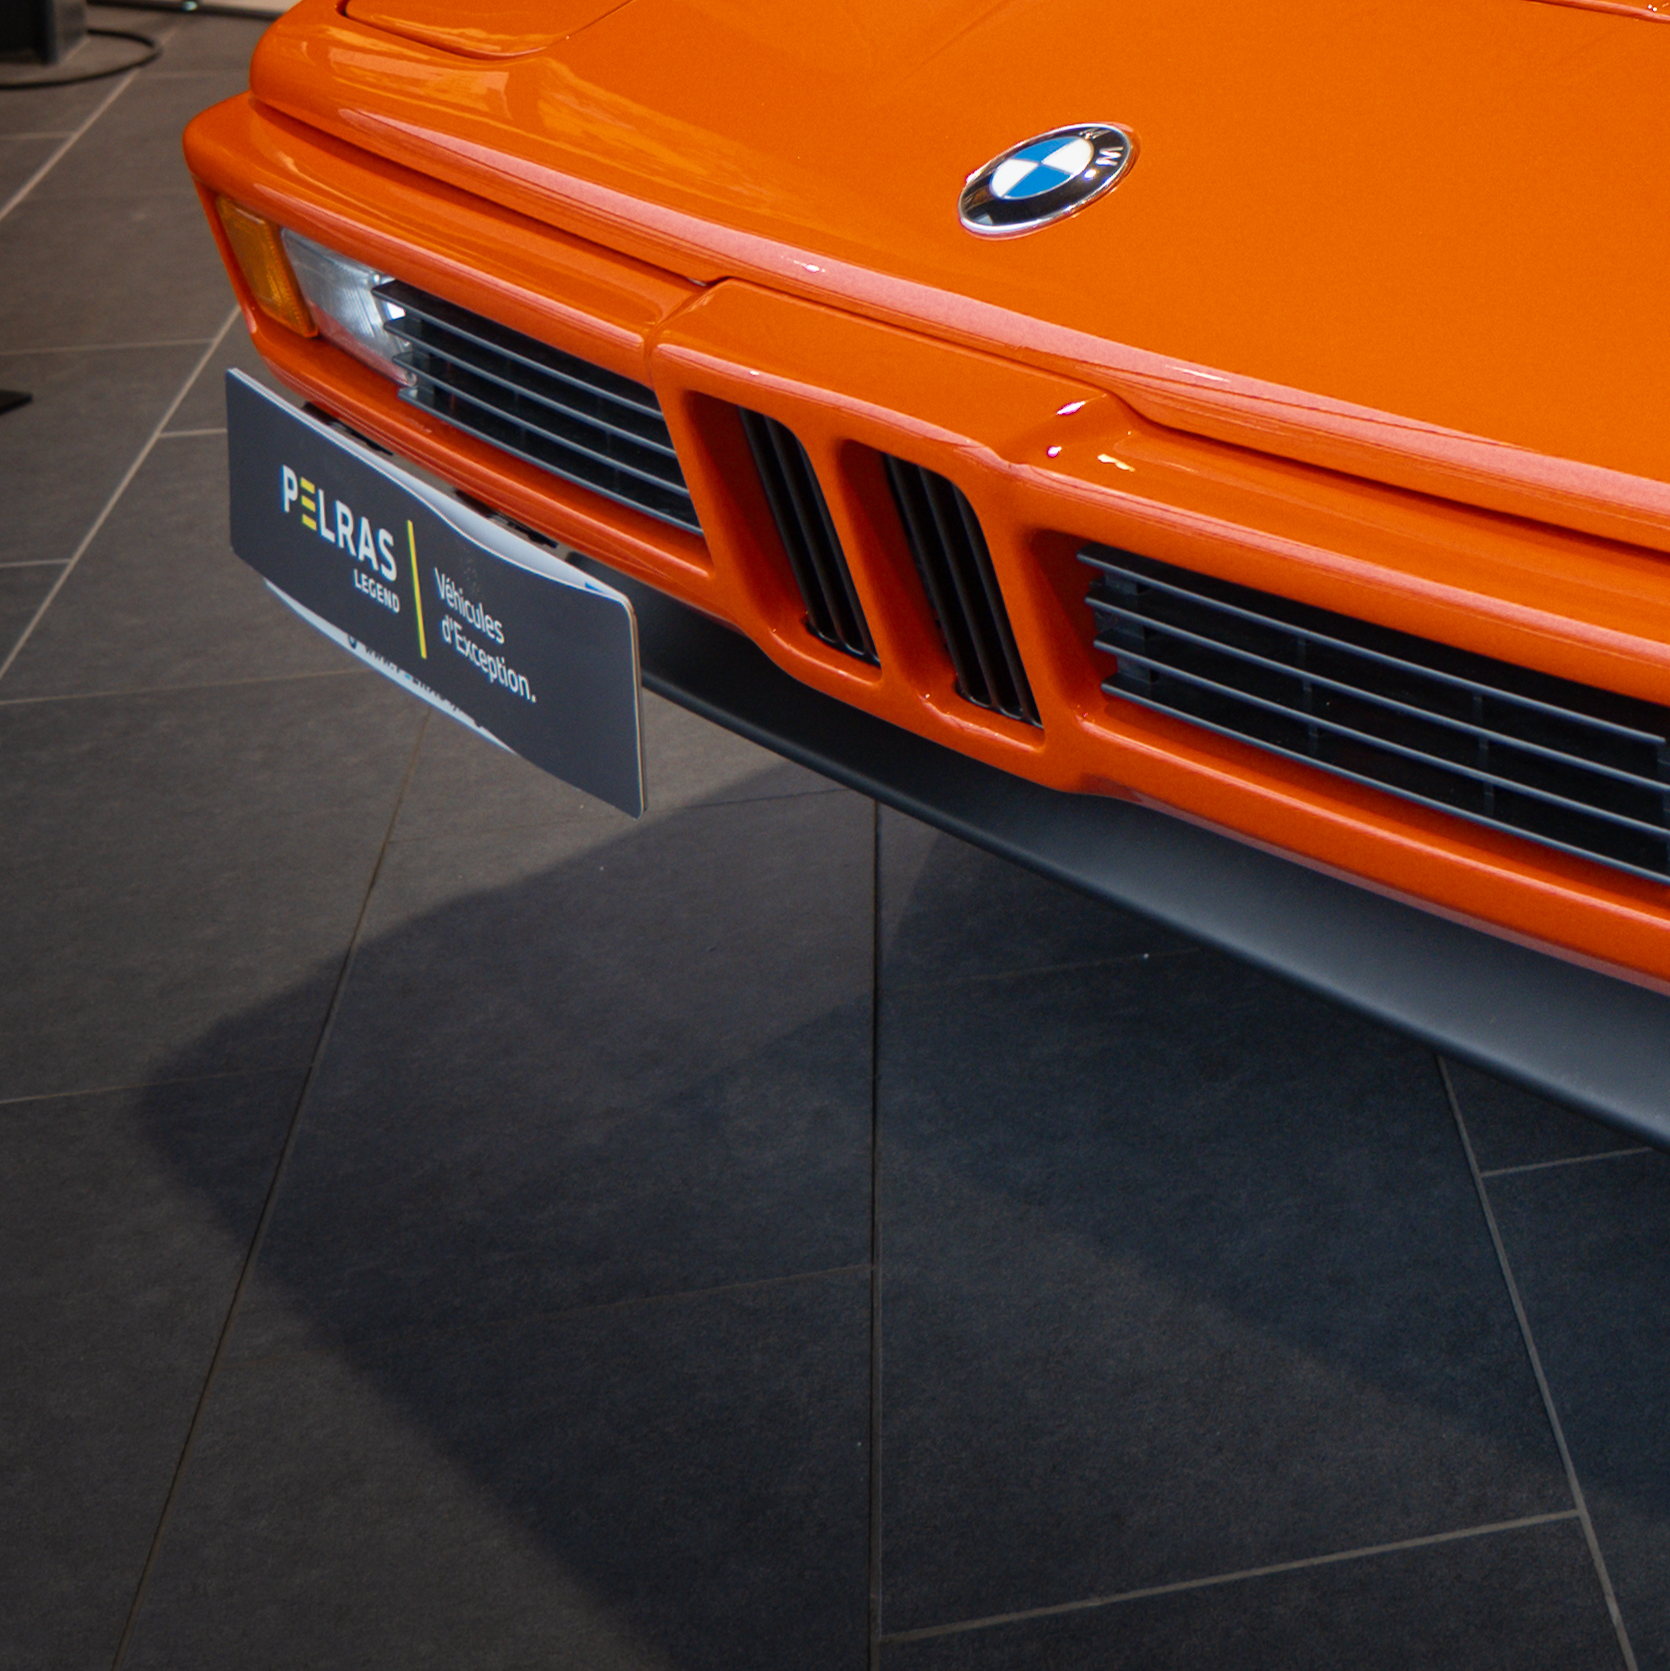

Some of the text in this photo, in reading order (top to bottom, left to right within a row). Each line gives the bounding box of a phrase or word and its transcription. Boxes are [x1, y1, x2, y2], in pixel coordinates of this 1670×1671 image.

[281, 464, 398, 582] PELRAS
[352, 568, 401, 614] LEGEND
[433, 565, 506, 645] Véhicules
[440, 614, 538, 704] d'Exception.
